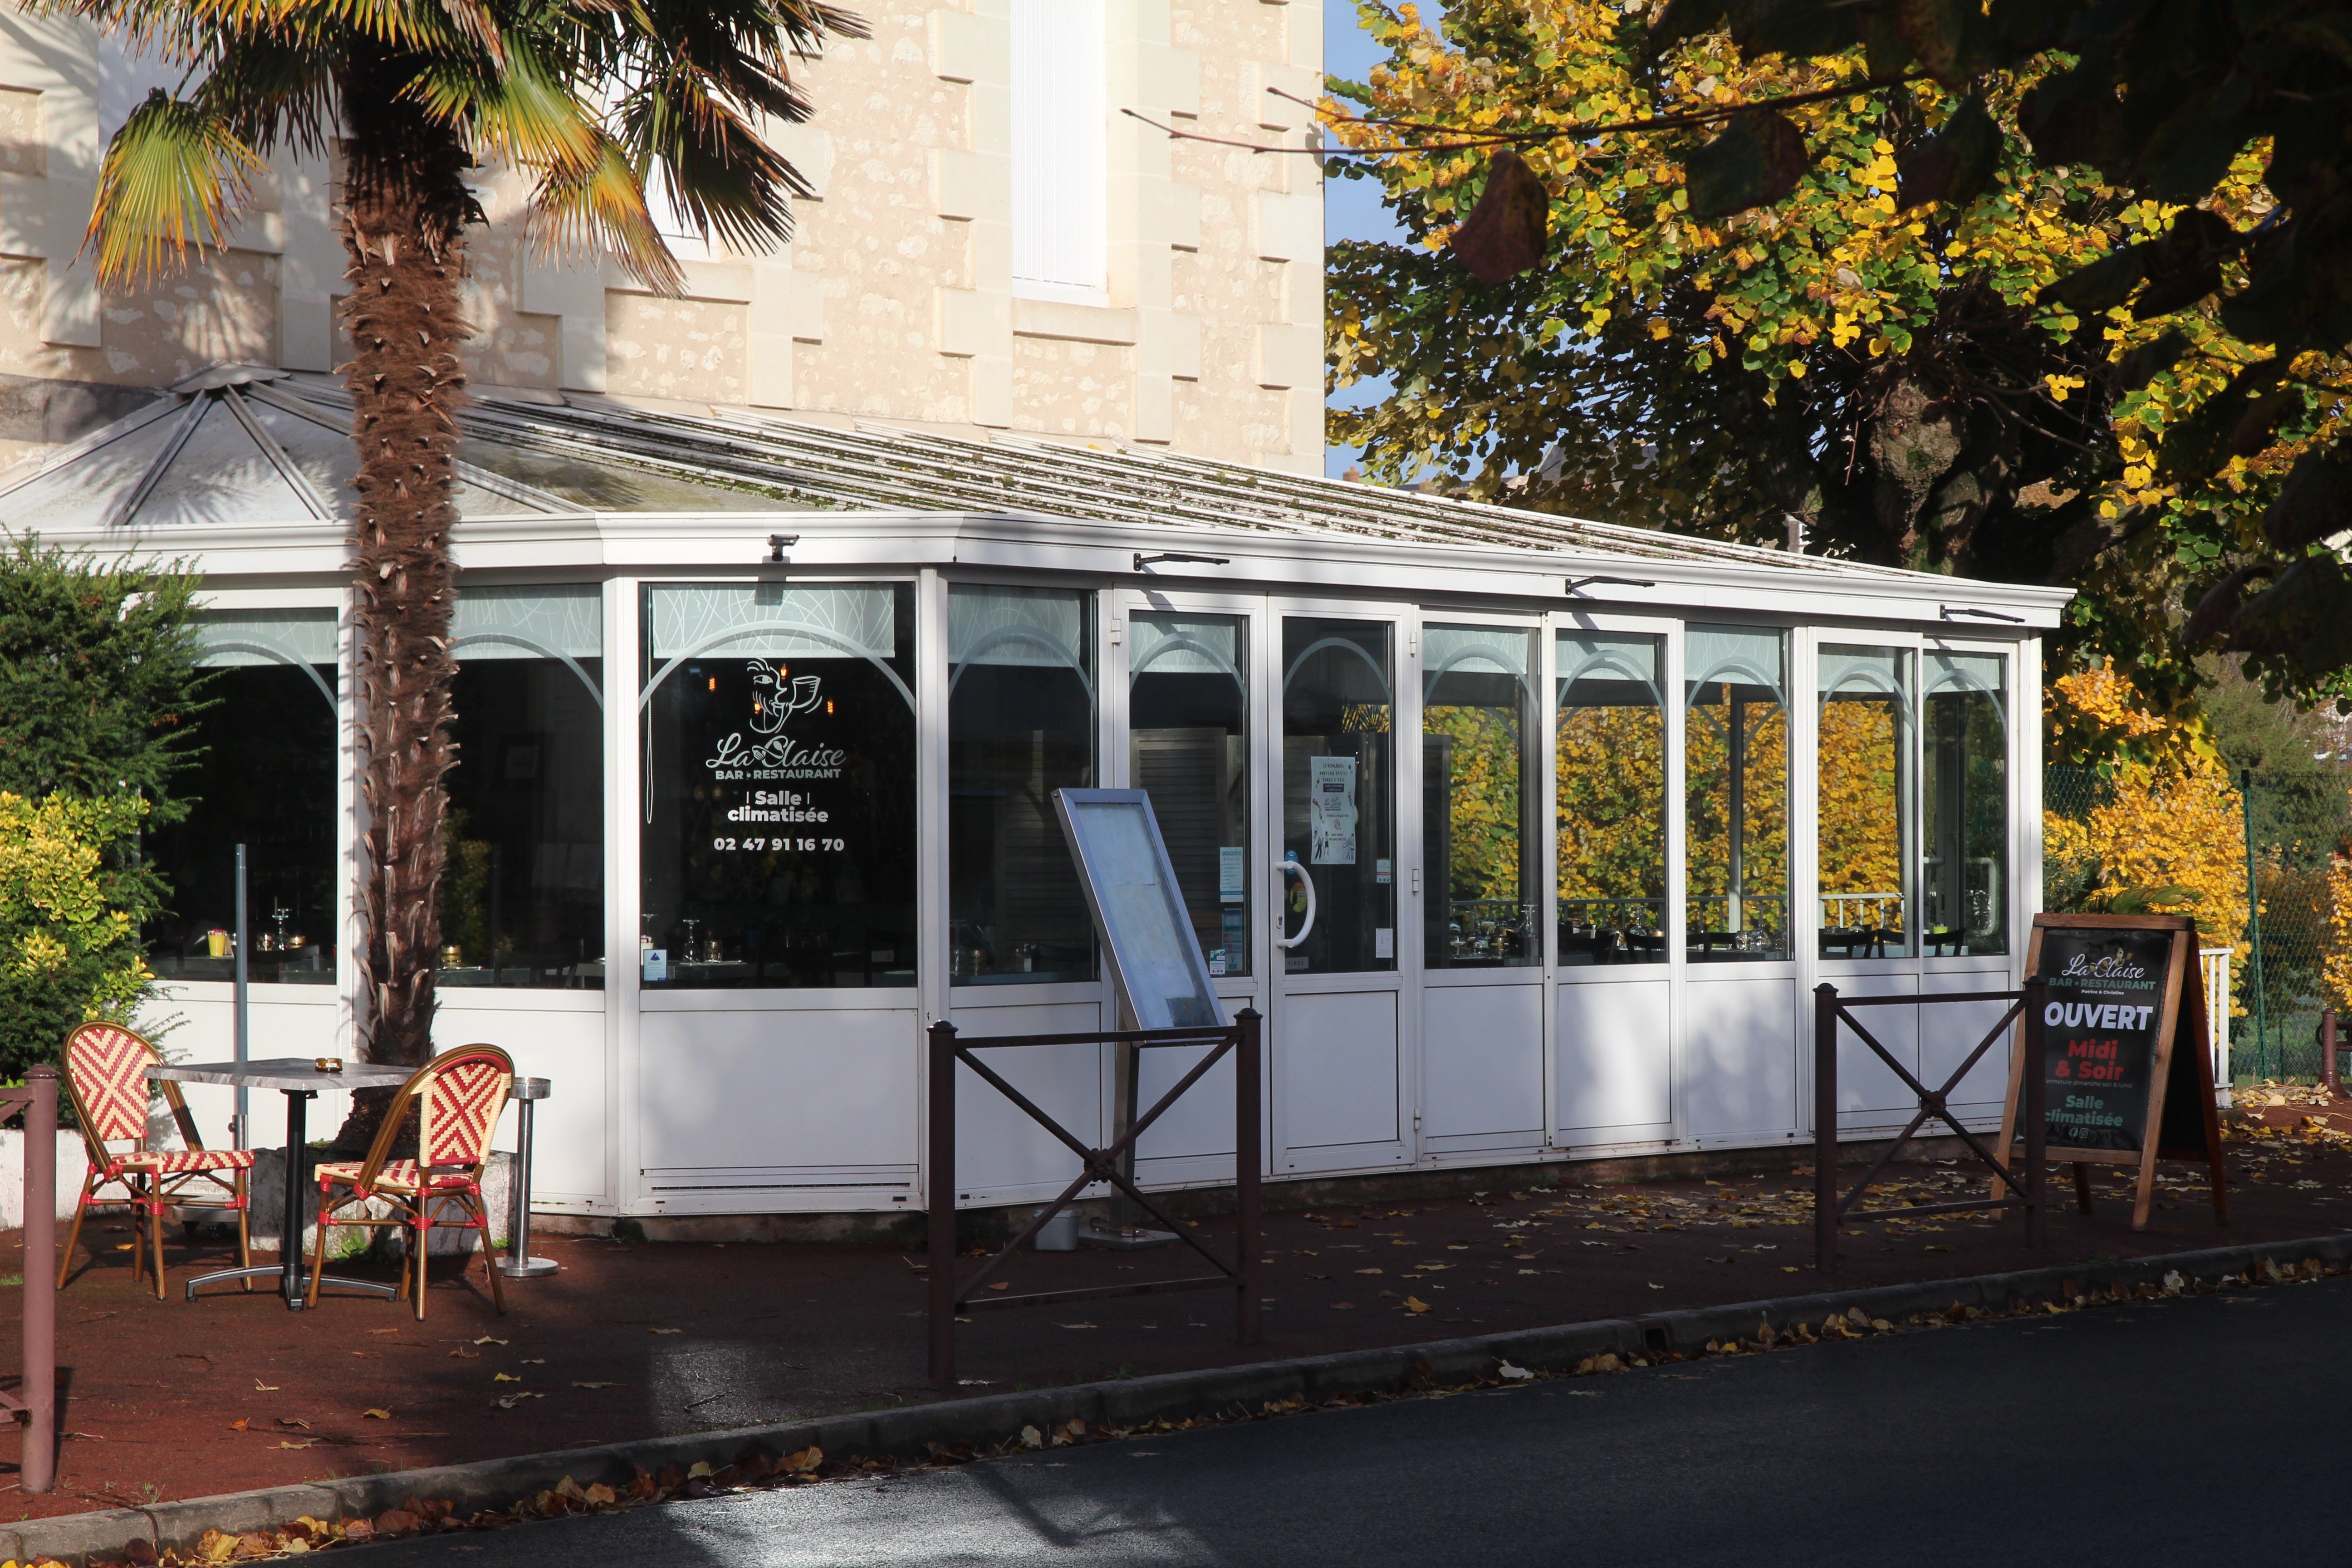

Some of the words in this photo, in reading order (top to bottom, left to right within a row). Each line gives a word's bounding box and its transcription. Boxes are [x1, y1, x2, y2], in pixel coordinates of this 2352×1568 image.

[706, 733, 754, 768] La
[761, 735, 847, 768] Claise
[715, 770, 744, 780] BAR
[753, 769, 841, 779] RESTAURANT
[755, 791, 802, 805] Salle
[727, 805, 828, 822] climatisée
[714, 838, 736, 850] 02
[742, 838, 765, 851] 47
[772, 838, 790, 851] 91
[796, 838, 815, 851] 16
[822, 838, 844, 851] 70
[2062, 954, 2091, 976] La
[2094, 956, 2145, 979] Claise
[2049, 977, 2073, 987] BAR
[2081, 979, 2156, 990] RESTAURANT
[2045, 1002, 2154, 1030] OUVERT
[2068, 1039, 2119, 1059] Midi
[2055, 1060, 2071, 1078] &
[2078, 1060, 2125, 1080] Soir
[2066, 1095, 2104, 1109] Salle
